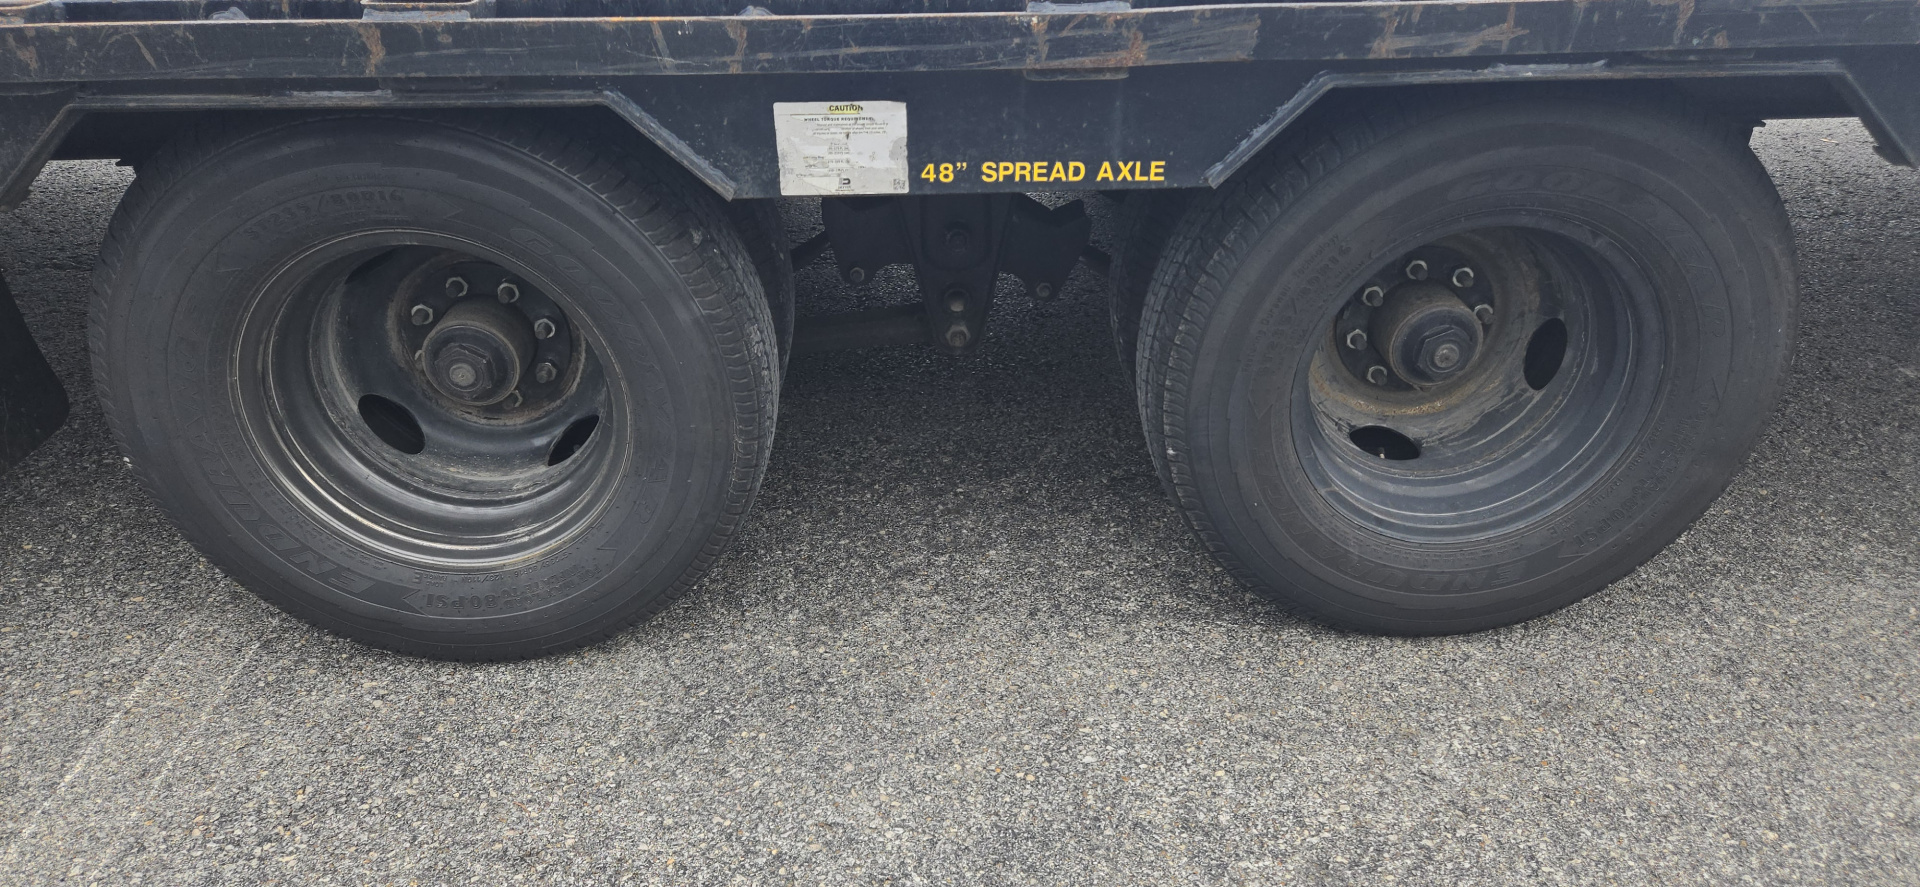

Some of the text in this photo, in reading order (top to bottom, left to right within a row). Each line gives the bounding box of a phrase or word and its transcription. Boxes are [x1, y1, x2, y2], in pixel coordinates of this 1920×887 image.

[829, 104, 863, 112] CAUTION
[982, 161, 1085, 183] SPREAD
[1097, 160, 1164, 182] AXLE
